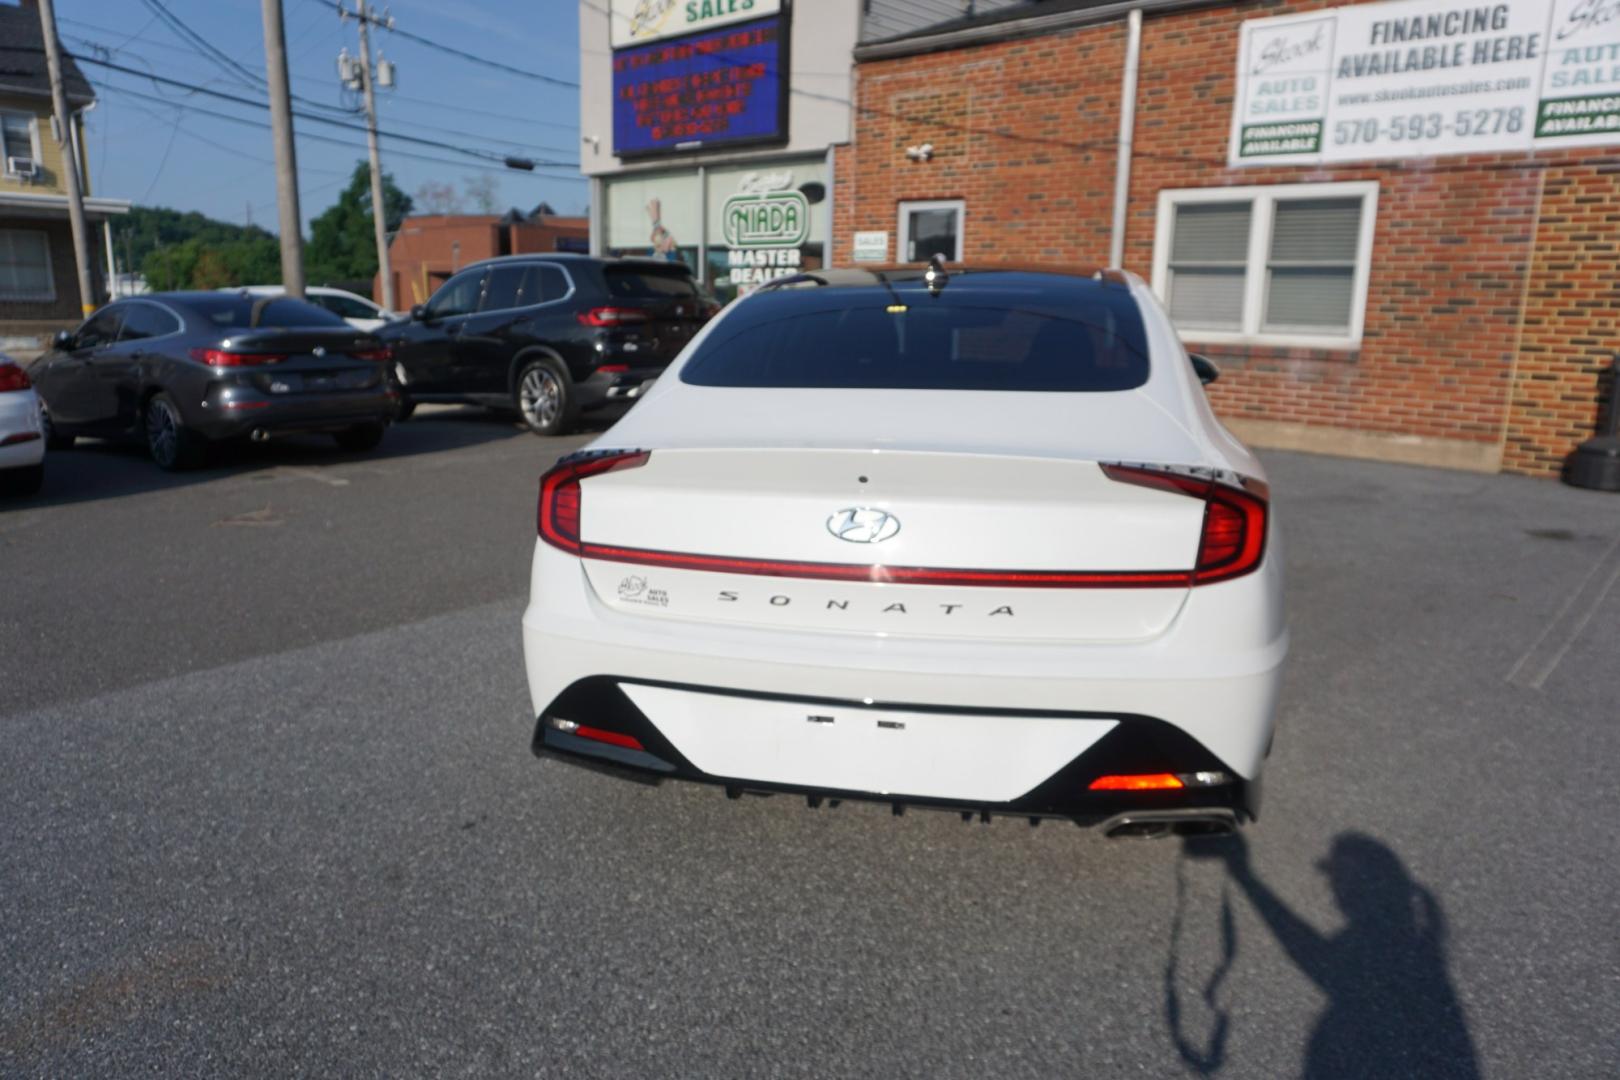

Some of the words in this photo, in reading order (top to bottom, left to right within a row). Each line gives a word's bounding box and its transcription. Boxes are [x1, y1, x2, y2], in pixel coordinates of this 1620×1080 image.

[1369, 4, 1509, 45] FINANCING
[1336, 41, 1468, 79] AVAILABLE
[1471, 32, 1540, 66] HERE
[1257, 77, 1317, 95] AUTO
[1250, 96, 1320, 114] SALES
[1244, 122, 1321, 139] FINANCING
[1334, 106, 1525, 145] 570-593-5278
[1242, 137, 1318, 154] AVAILABLE
[730, 204, 799, 236] NIADA
[728, 249, 801, 267] MASTER
[717, 590, 1015, 616] SONATA
